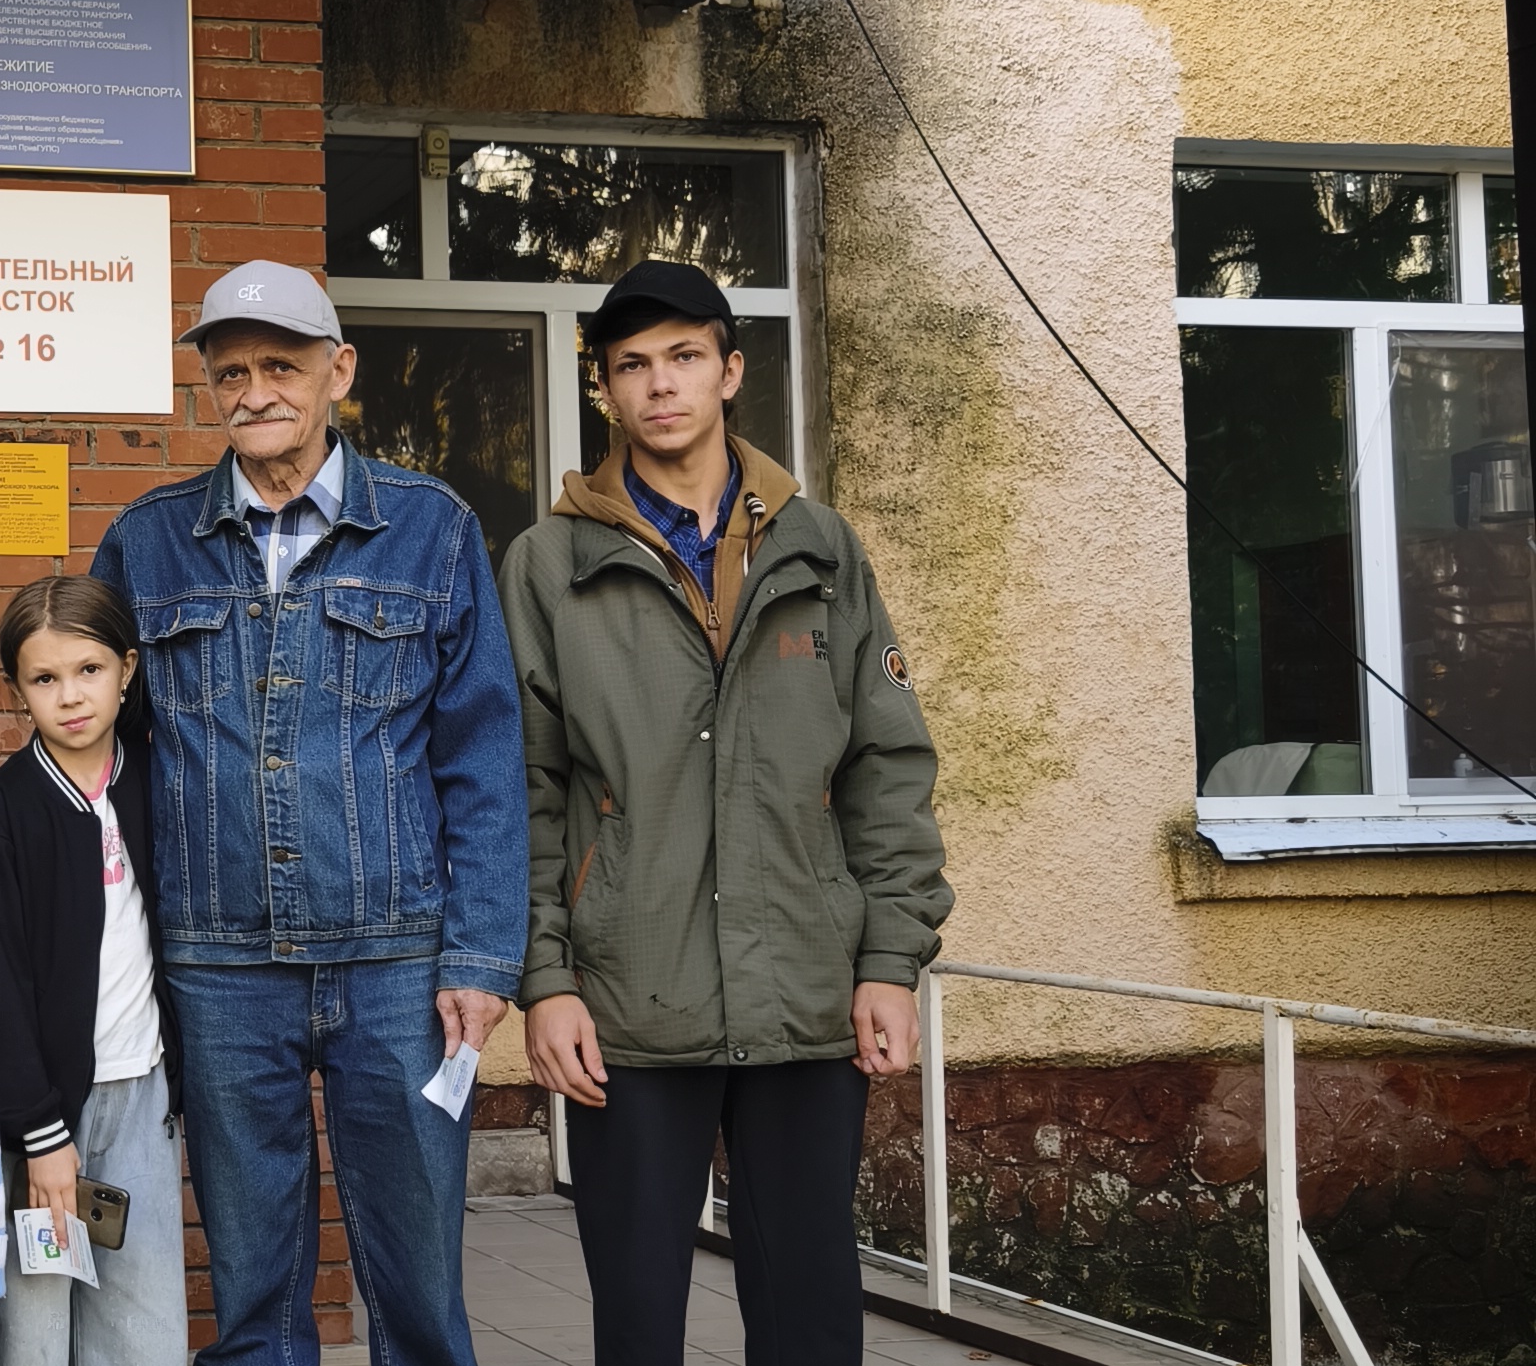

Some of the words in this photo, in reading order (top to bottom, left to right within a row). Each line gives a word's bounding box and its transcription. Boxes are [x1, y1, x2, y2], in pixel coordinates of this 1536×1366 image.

[71, 0, 121, 10] ФЕДЕРАЦИИ
[81, 10, 134, 21] ТРАНСПОРТА
[51, 19, 104, 29] БЮДЖЕТНОЕ
[25, 28, 65, 38] ВЫСШЕГО
[66, 30, 126, 40] ОБРАЗОВАНИЯ
[10, 37, 68, 48] УНИВЕРСИТЕТ
[69, 39, 96, 49] ПУТЕЙ
[104, 85, 183, 99] ТРАНСПОРТА
[18, 333, 56, 362] 16
